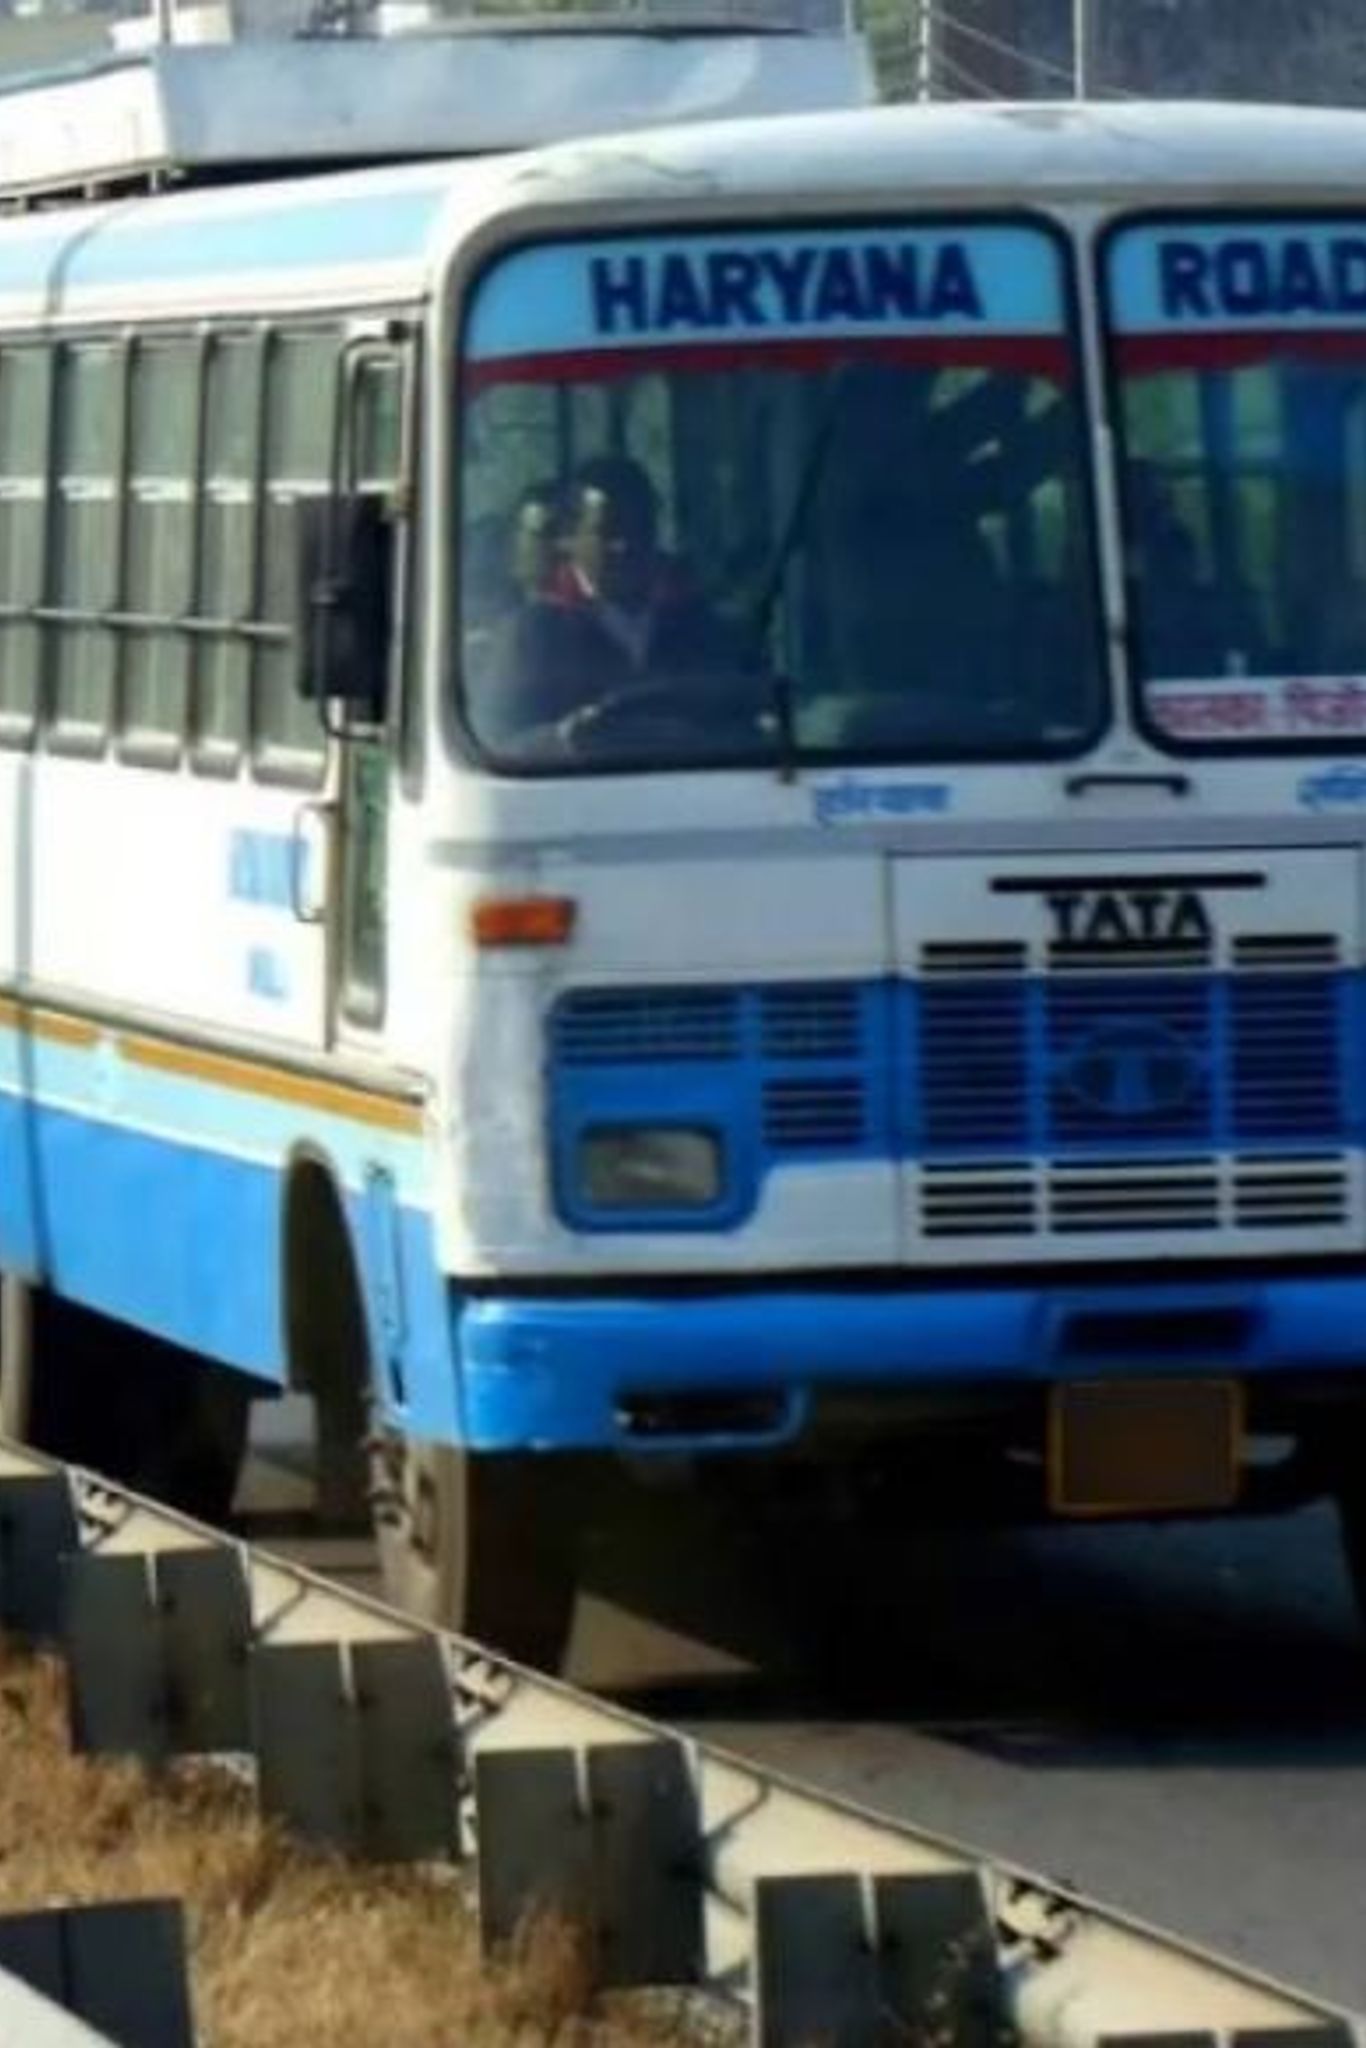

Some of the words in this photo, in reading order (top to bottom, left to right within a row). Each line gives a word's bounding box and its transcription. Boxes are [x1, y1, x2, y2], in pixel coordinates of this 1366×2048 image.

[589, 243, 985, 333] HARYANA
[1157, 239, 1366, 318] ROAD
[1046, 891, 1213, 943] TATA
